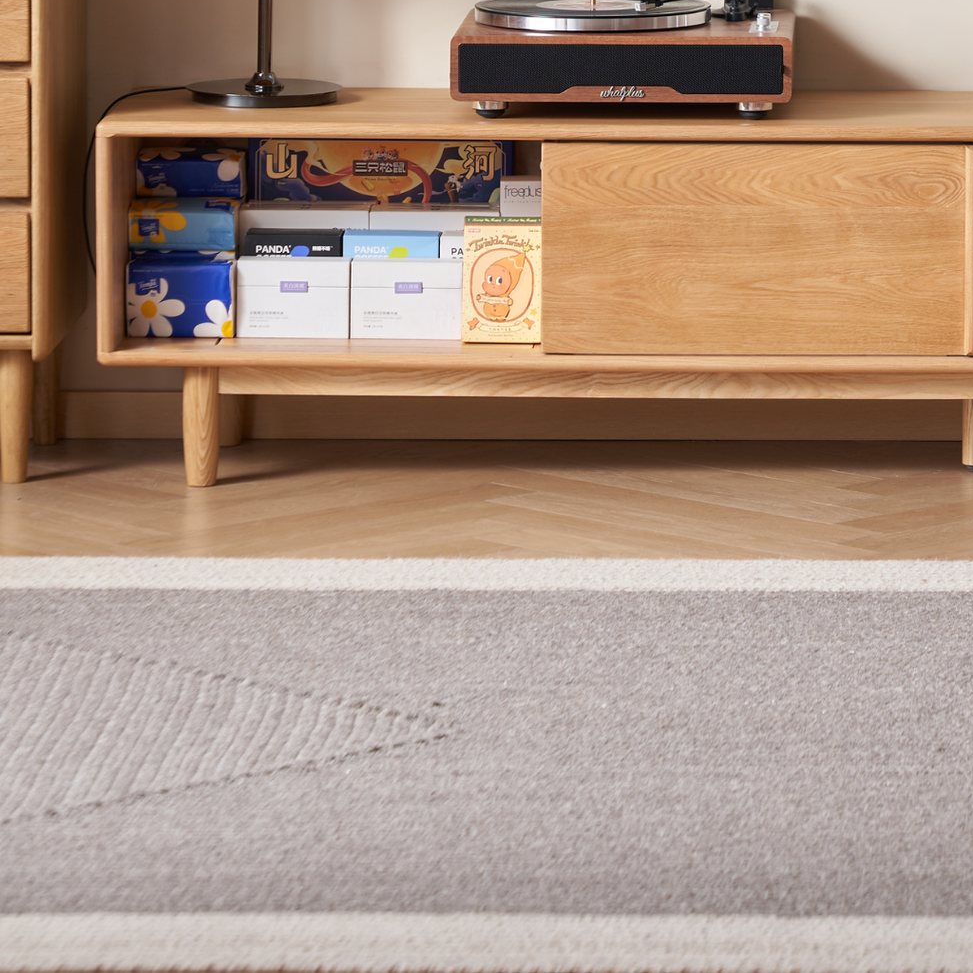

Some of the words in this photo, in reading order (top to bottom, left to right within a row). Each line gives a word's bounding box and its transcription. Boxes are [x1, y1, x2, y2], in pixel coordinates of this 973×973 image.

[265, 142, 298, 179] 山
[463, 144, 498, 180] 河
[355, 161, 406, 174] 三只松鼠
[256, 245, 290, 253] PANDA
[354, 246, 387, 254] PANDA
